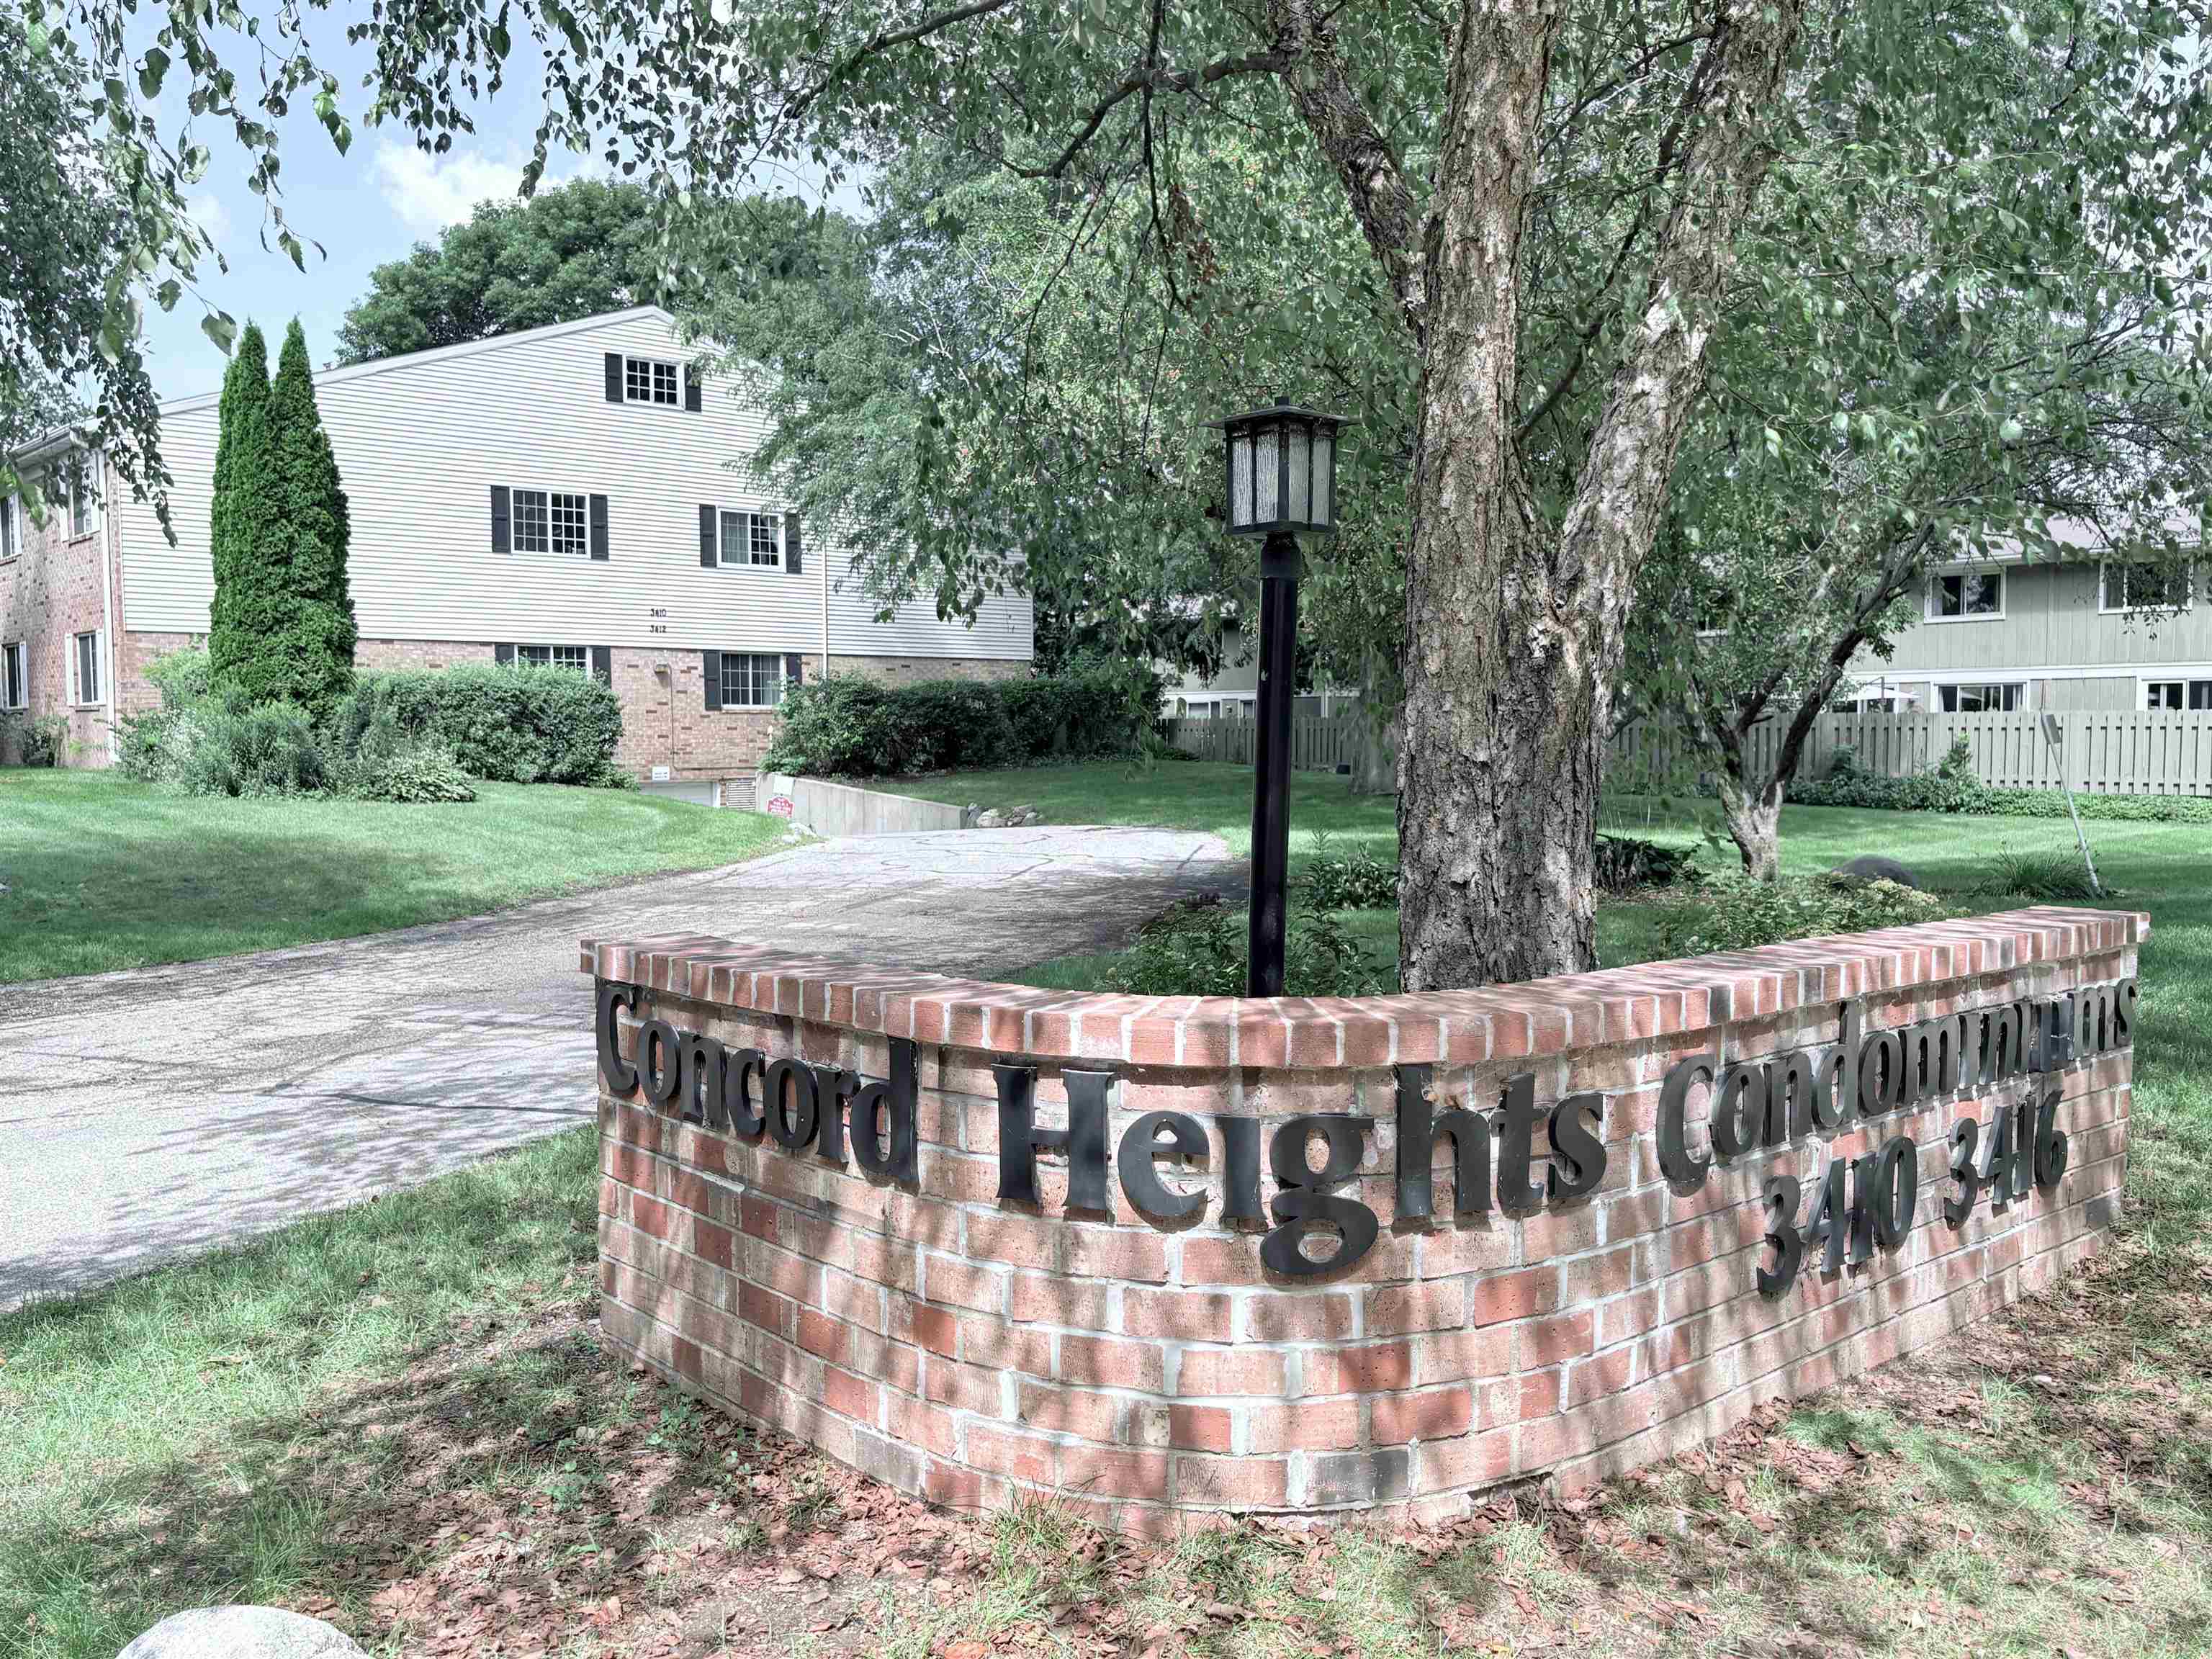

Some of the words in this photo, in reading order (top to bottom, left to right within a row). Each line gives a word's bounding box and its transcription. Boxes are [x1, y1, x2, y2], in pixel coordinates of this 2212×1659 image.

[649, 625, 667, 634] 3412
[650, 608, 667, 617] 3410
[596, 984, 920, 1183] Concord
[991, 1063, 1607, 1274] Heights
[1656, 978, 2137, 1183] Condominiums
[1757, 1136, 1917, 1296] 3410
[1945, 1090, 2068, 1230] 3416
